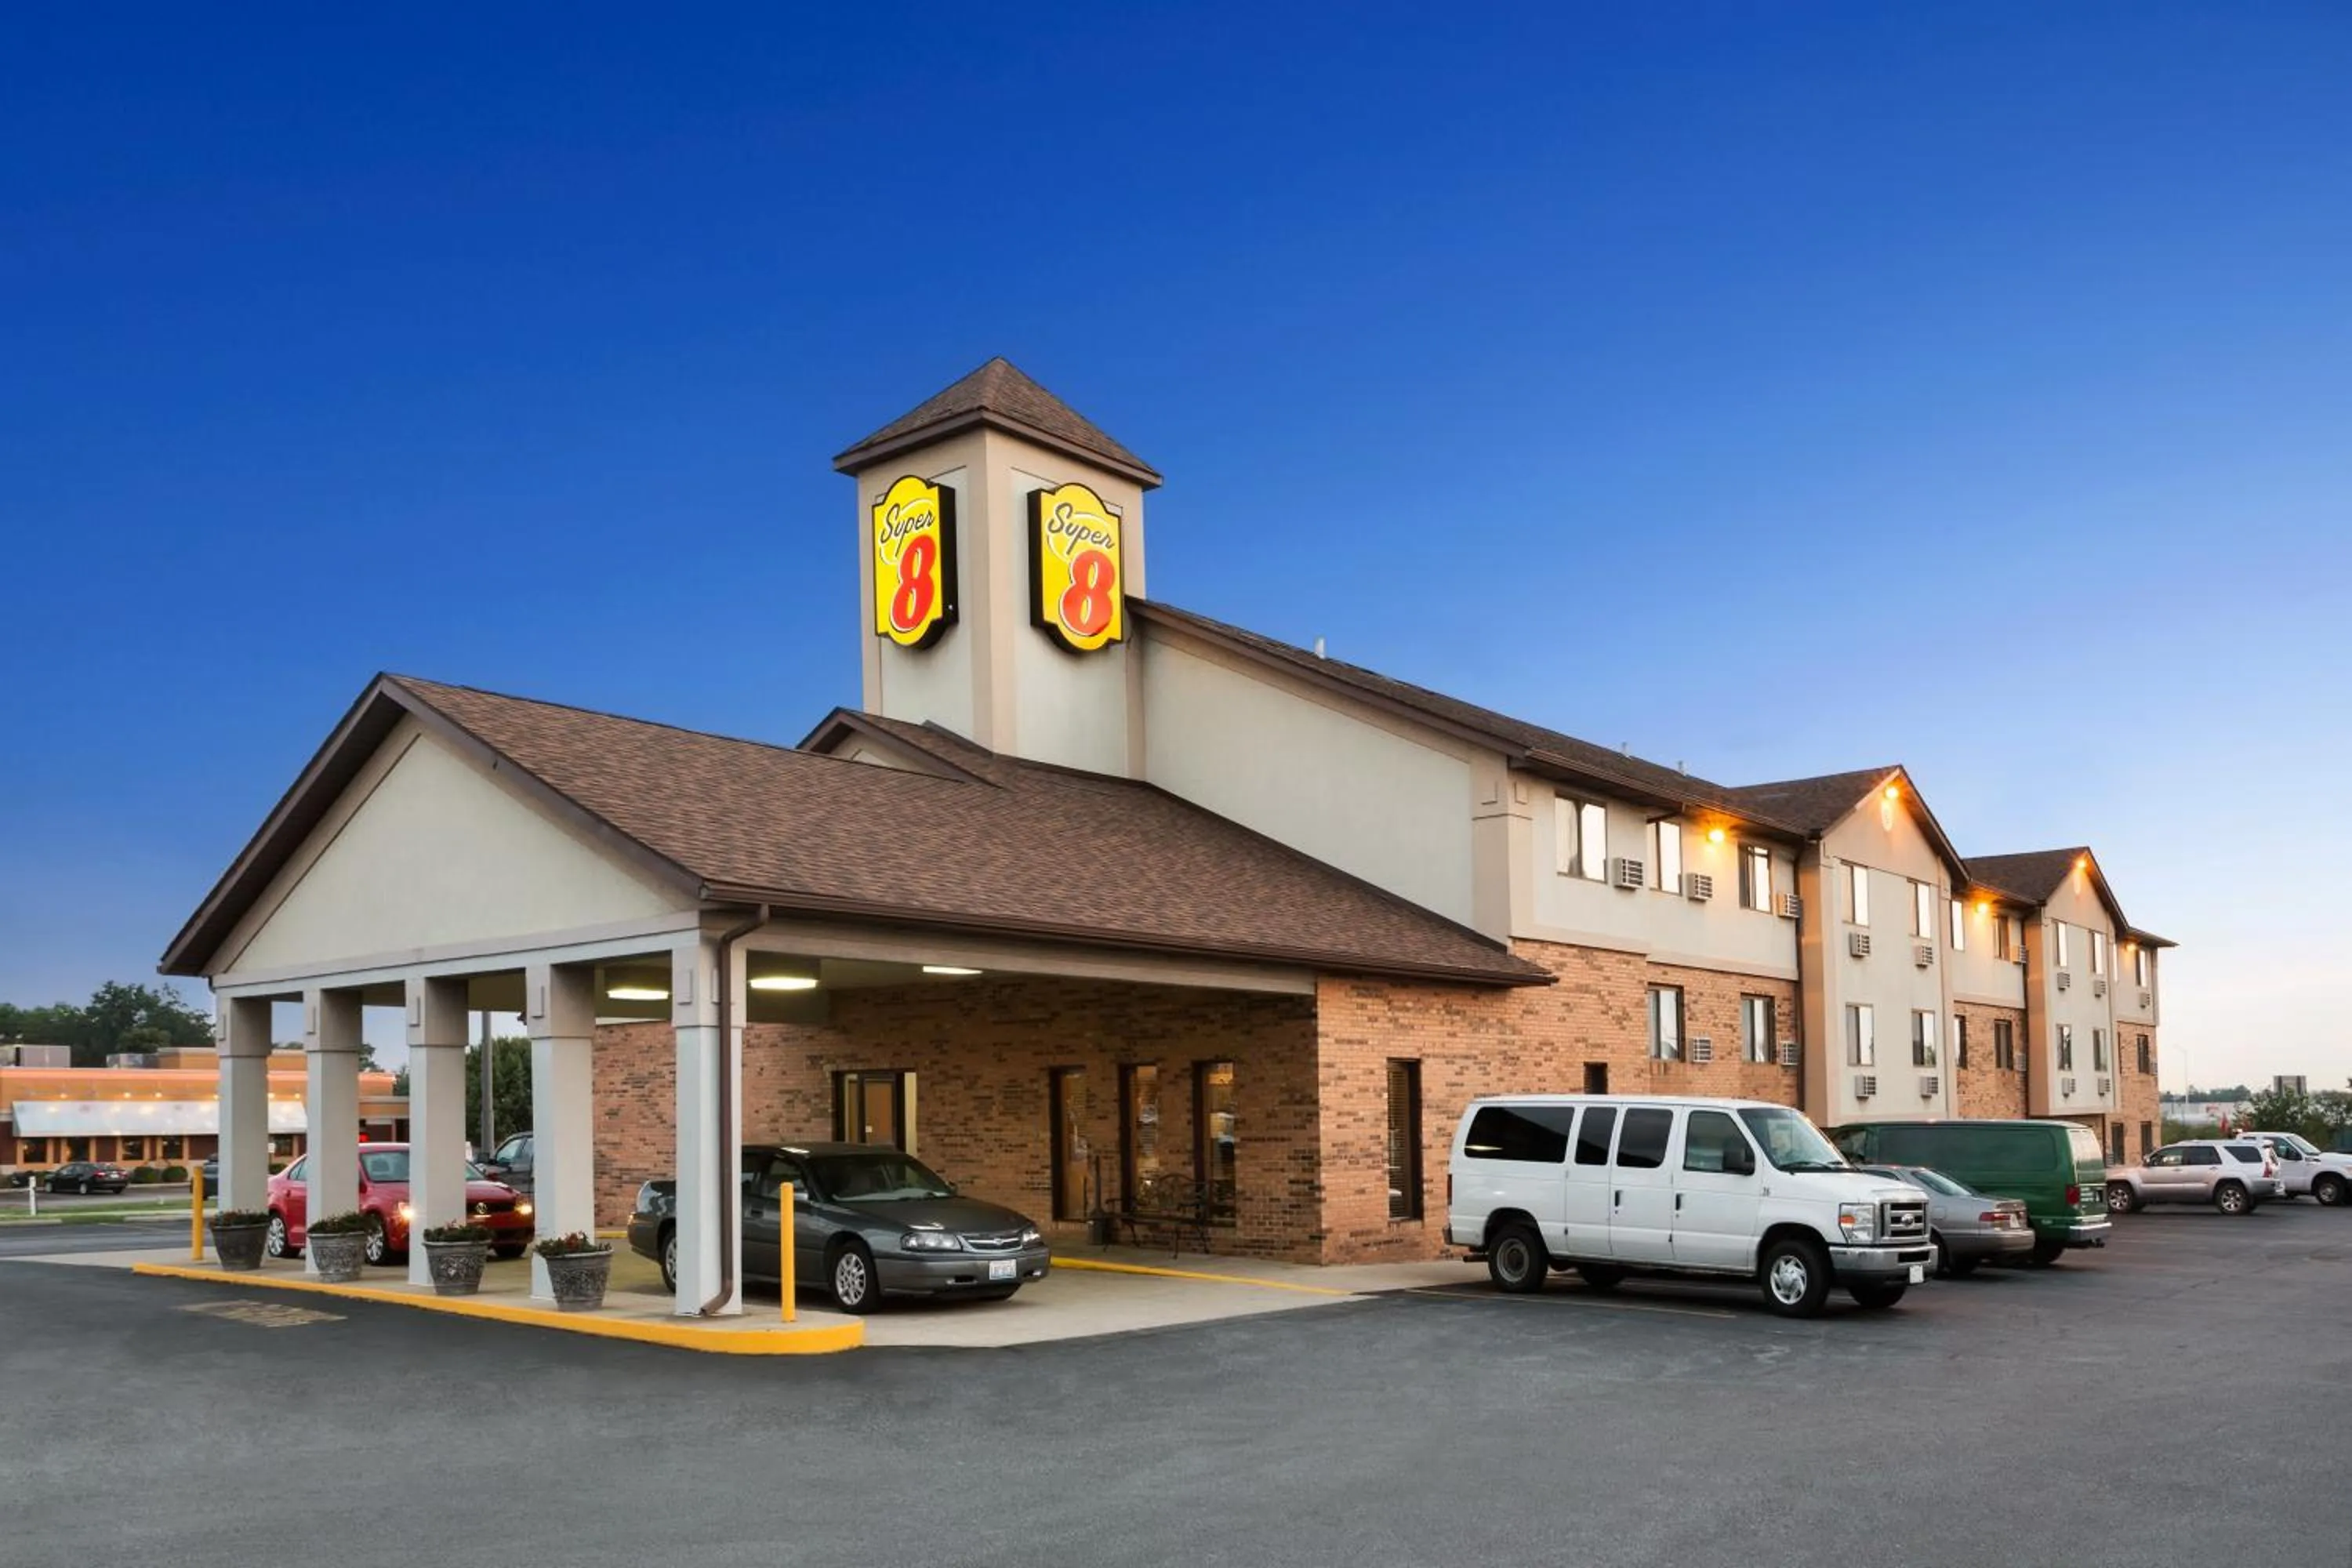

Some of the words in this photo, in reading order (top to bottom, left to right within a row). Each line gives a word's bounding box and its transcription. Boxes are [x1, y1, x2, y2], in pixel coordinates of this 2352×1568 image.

[880, 503, 935, 557] Super
[1047, 503, 1115, 555] Super
[891, 534, 936, 633] 8
[1060, 550, 1116, 637] 8
